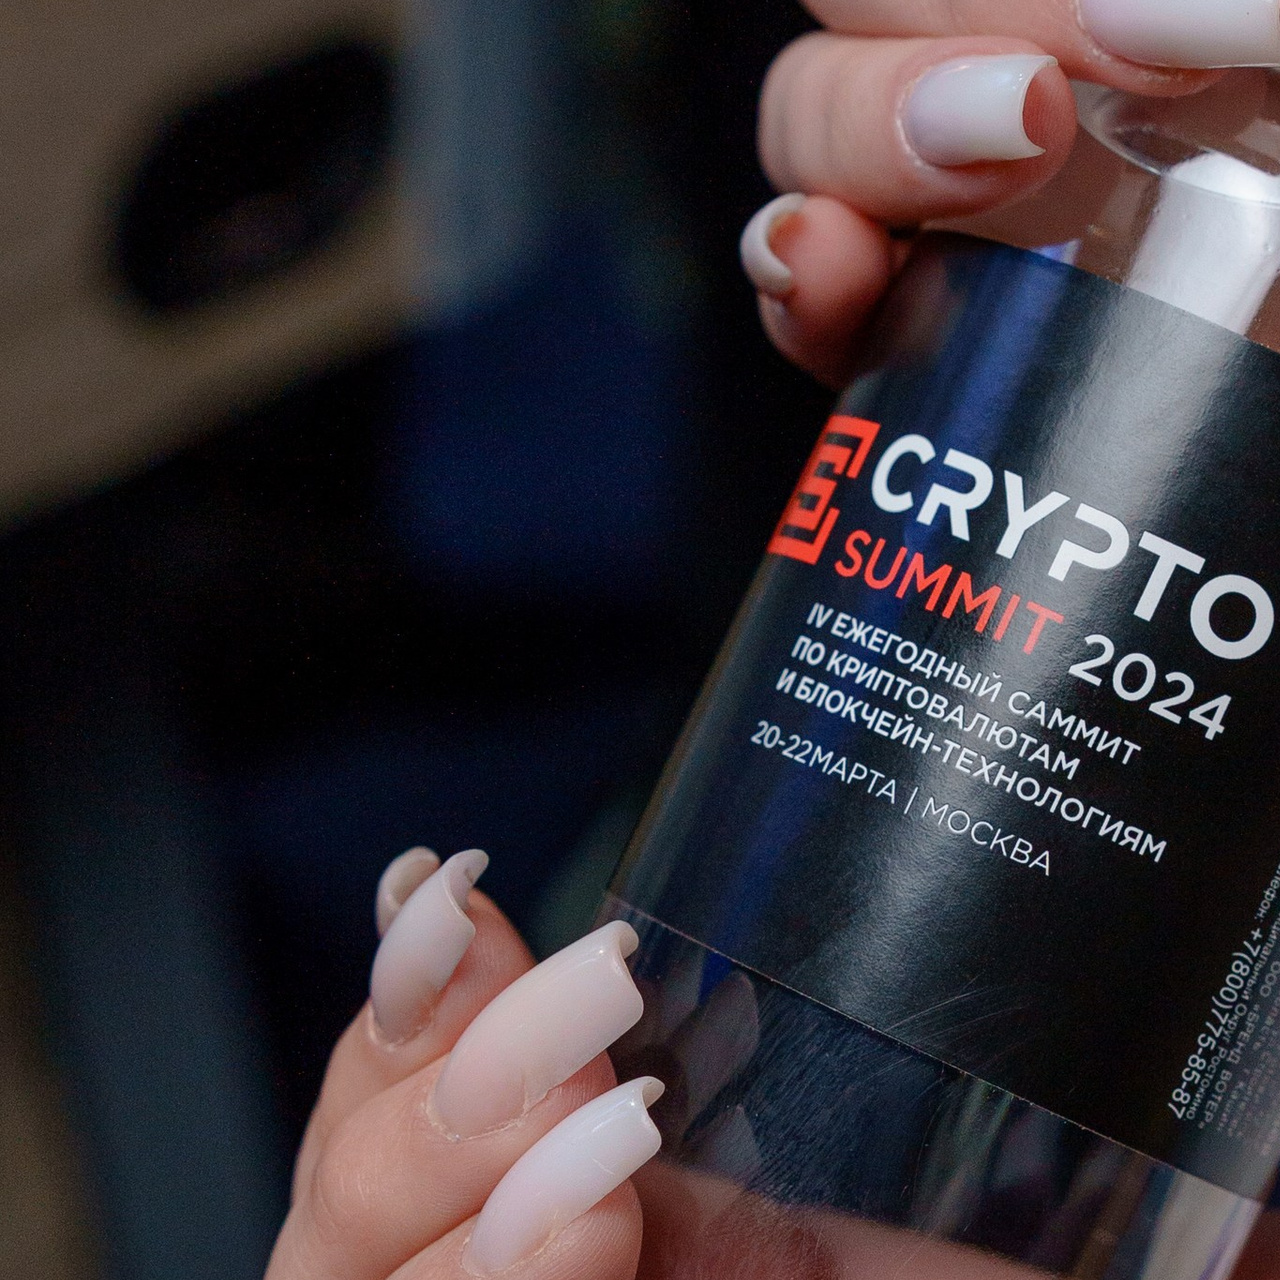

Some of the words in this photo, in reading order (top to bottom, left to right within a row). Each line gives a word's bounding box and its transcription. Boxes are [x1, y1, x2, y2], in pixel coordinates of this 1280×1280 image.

[834, 529, 1064, 655] SUMMIT
[1068, 633, 1232, 742] 2024
[871, 433, 1275, 660] CRYPTO
[777, 669, 796, 696] И
[796, 676, 1167, 863] БЛОКЧЕЙН-ТЕХНОЛОГИЯМ
[791, 634, 826, 664] ПО
[826, 645, 1081, 782] КРИПТОВАЛЮТАМ
[807, 602, 834, 630] IV
[835, 610, 1003, 704] ЕЖЕГОДНЫЙ
[1008, 689, 1141, 770] САММИТ
[921, 795, 1052, 878] МОСКВА
[1163, 925, 1265, 1117] +7(800)775-85-87
[1221, 1002, 1247, 1042] Округ
